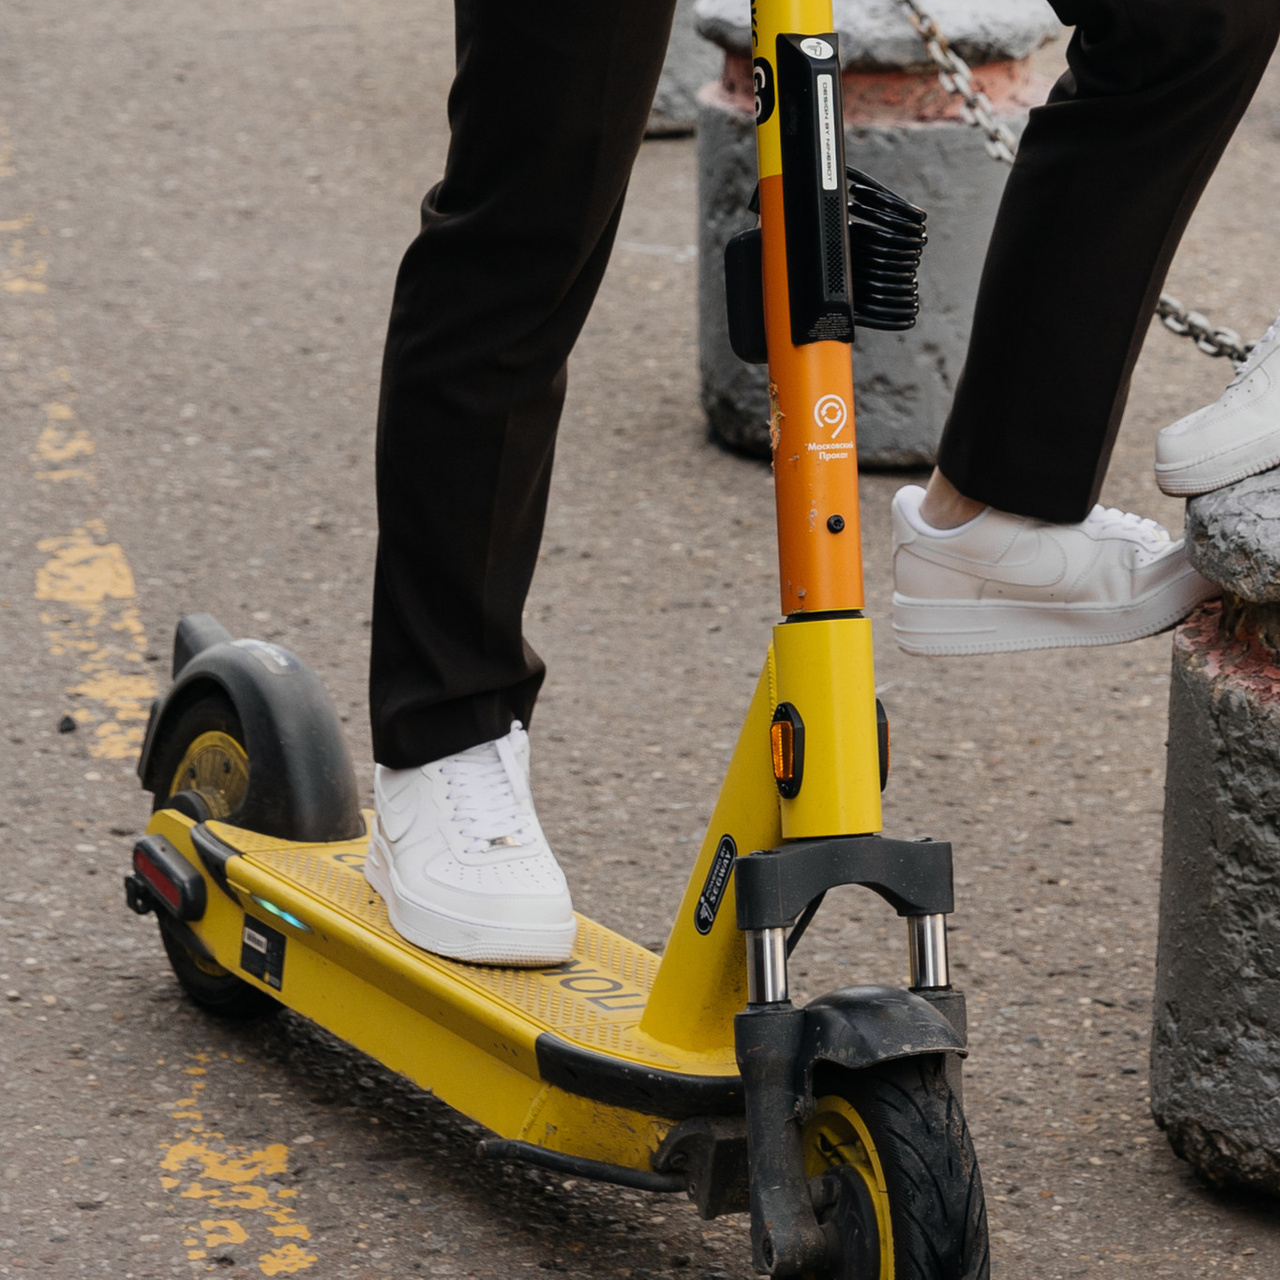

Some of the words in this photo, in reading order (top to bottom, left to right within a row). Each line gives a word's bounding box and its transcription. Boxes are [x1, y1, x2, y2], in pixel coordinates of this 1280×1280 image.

[822, 81, 830, 120] DESIGN
[824, 122, 830, 135] BY
[825, 138, 833, 181] NINEBOT
[808, 441, 854, 451] Московский
[819, 451, 848, 461] Прокат
[706, 858, 722, 898] POWERED
[719, 844, 726, 858] BY
[710, 850, 731, 904] SEGWAY
